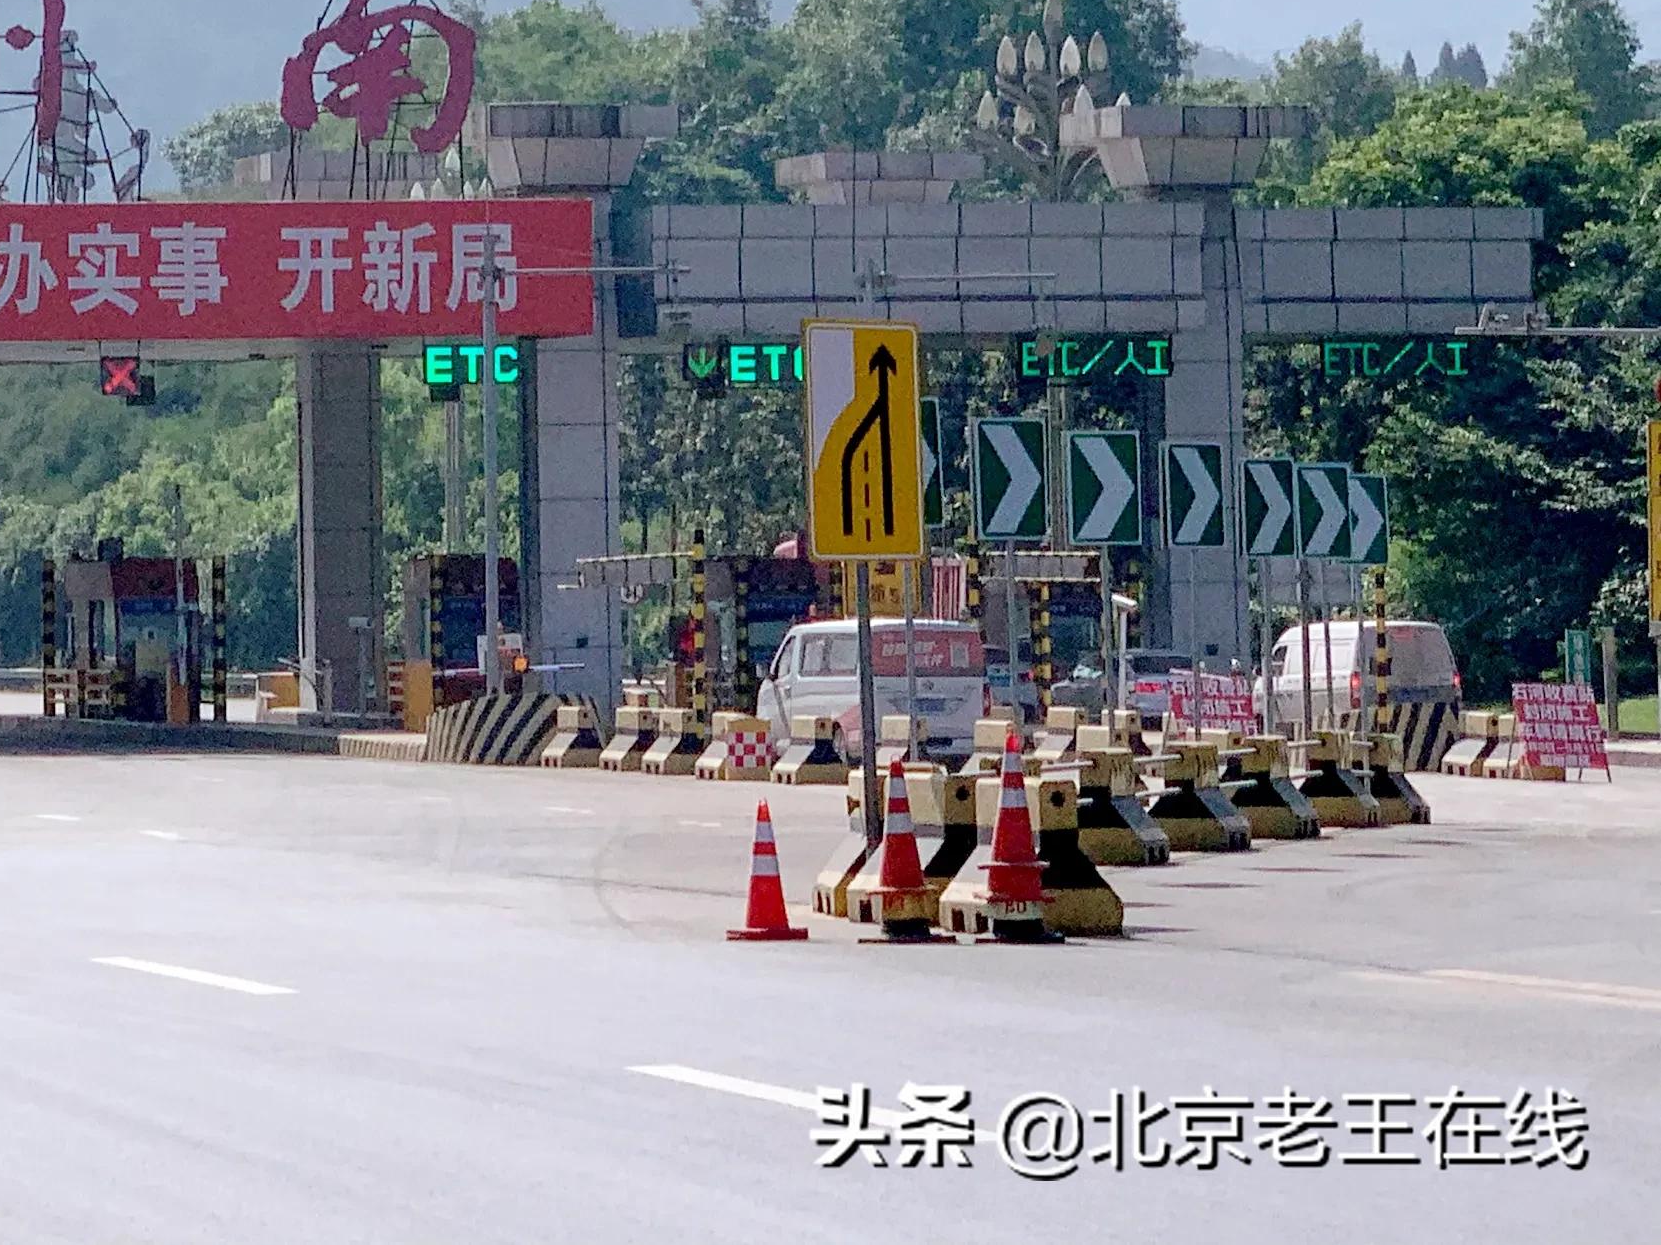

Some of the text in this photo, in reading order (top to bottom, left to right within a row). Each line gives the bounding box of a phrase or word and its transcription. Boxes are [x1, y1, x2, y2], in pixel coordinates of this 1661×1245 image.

[277, 221, 520, 315] 开新局
[425, 344, 520, 384] ETC
[1021, 339, 1171, 377] ETC/人工
[1323, 340, 1469, 377] ETC/人工
